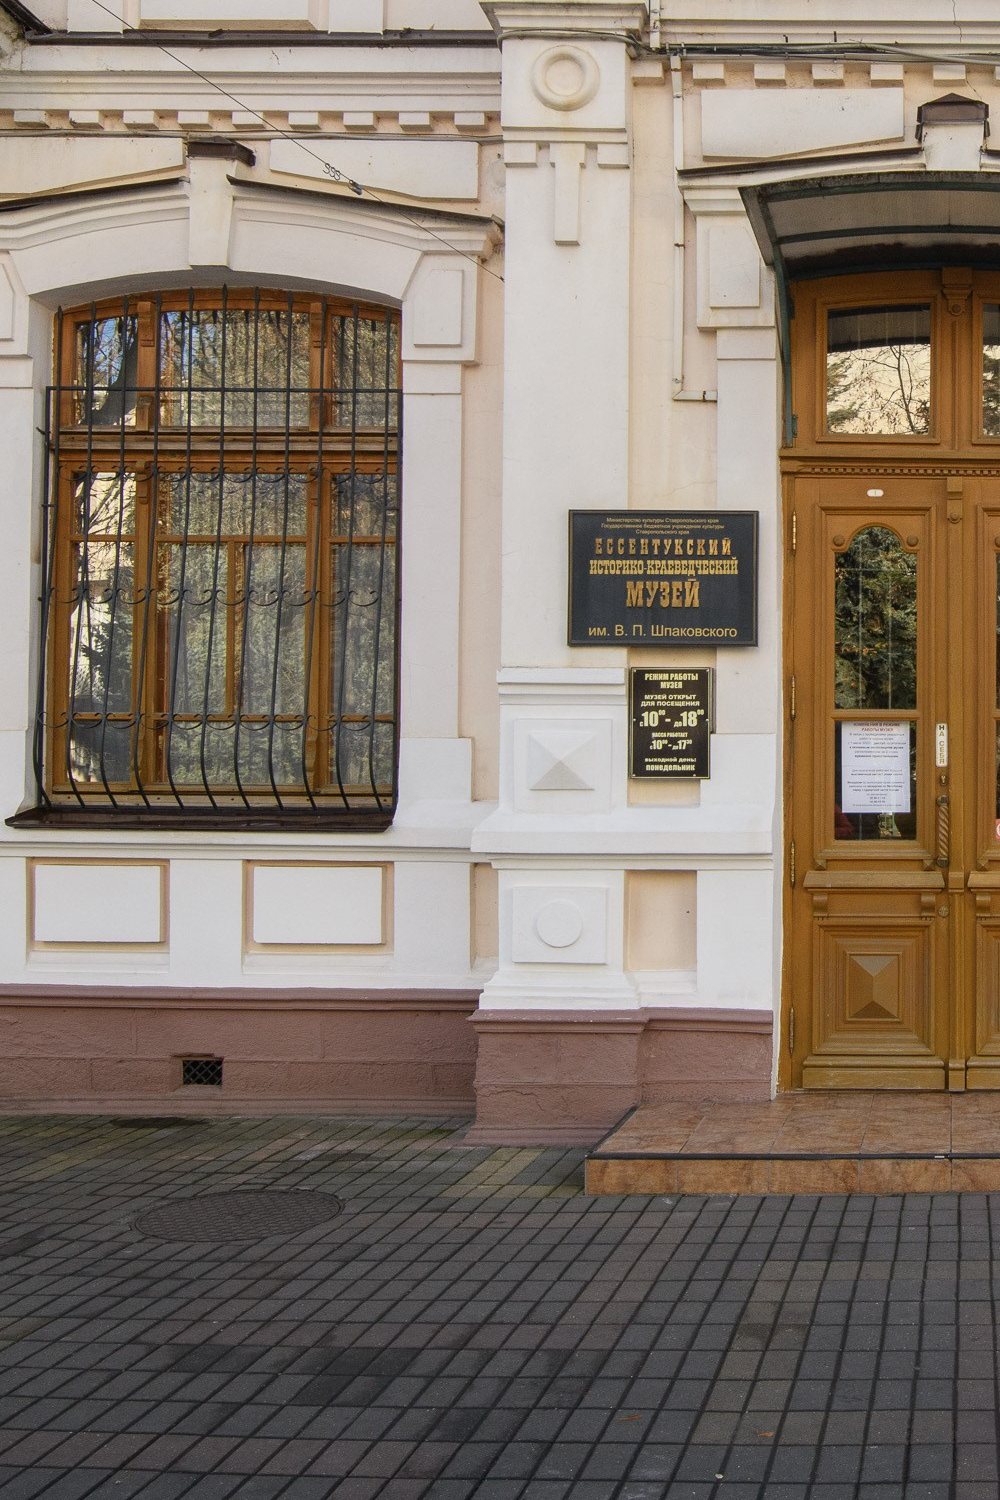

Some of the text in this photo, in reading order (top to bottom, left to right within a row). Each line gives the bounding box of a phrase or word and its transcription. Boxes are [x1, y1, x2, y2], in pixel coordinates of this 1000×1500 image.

[595, 537, 732, 555] ЕССЕНТУКСКИЙ
[589, 556, 738, 576] ИСТОРИКО-КРАЕВЕДЧЕСКИЙ
[626, 578, 700, 607] МУЗЕЙ
[588, 624, 738, 637] им. В. П. Шпаковского
[644, 673, 699, 681] РЕЖИМ РАБОТЫ
[660, 681, 683, 689] МУЗЕЯ
